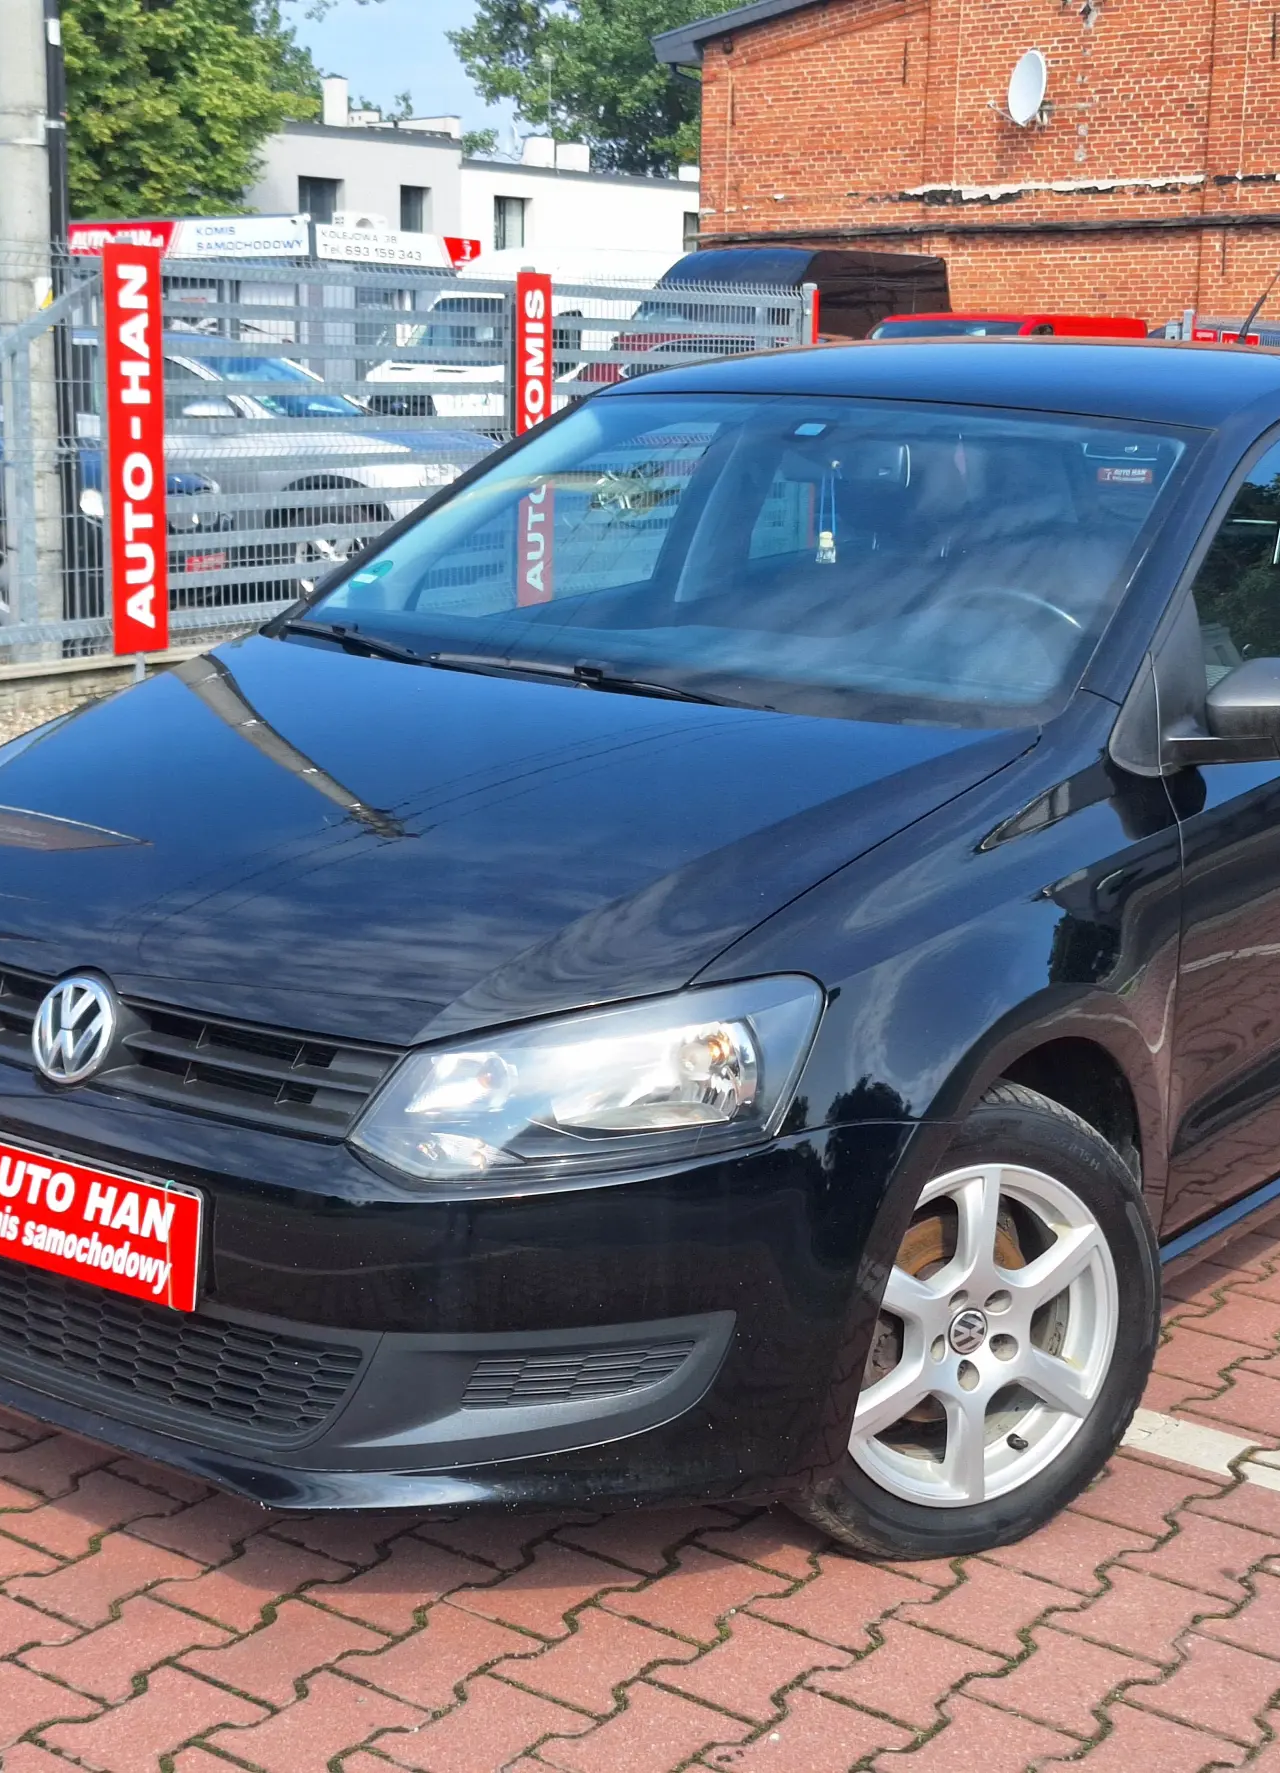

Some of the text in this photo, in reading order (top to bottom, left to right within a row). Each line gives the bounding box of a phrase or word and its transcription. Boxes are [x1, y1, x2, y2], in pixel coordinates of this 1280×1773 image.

[196, 226, 236, 236] KOMIS
[320, 230, 378, 242] KOLEJOWA
[196, 239, 304, 250] SAMOCHODOWY
[345, 245, 370, 256] 693
[398, 250, 422, 261] 343
[82, 1181, 176, 1243] HAN
[21, 1219, 172, 1295] samochodowy
